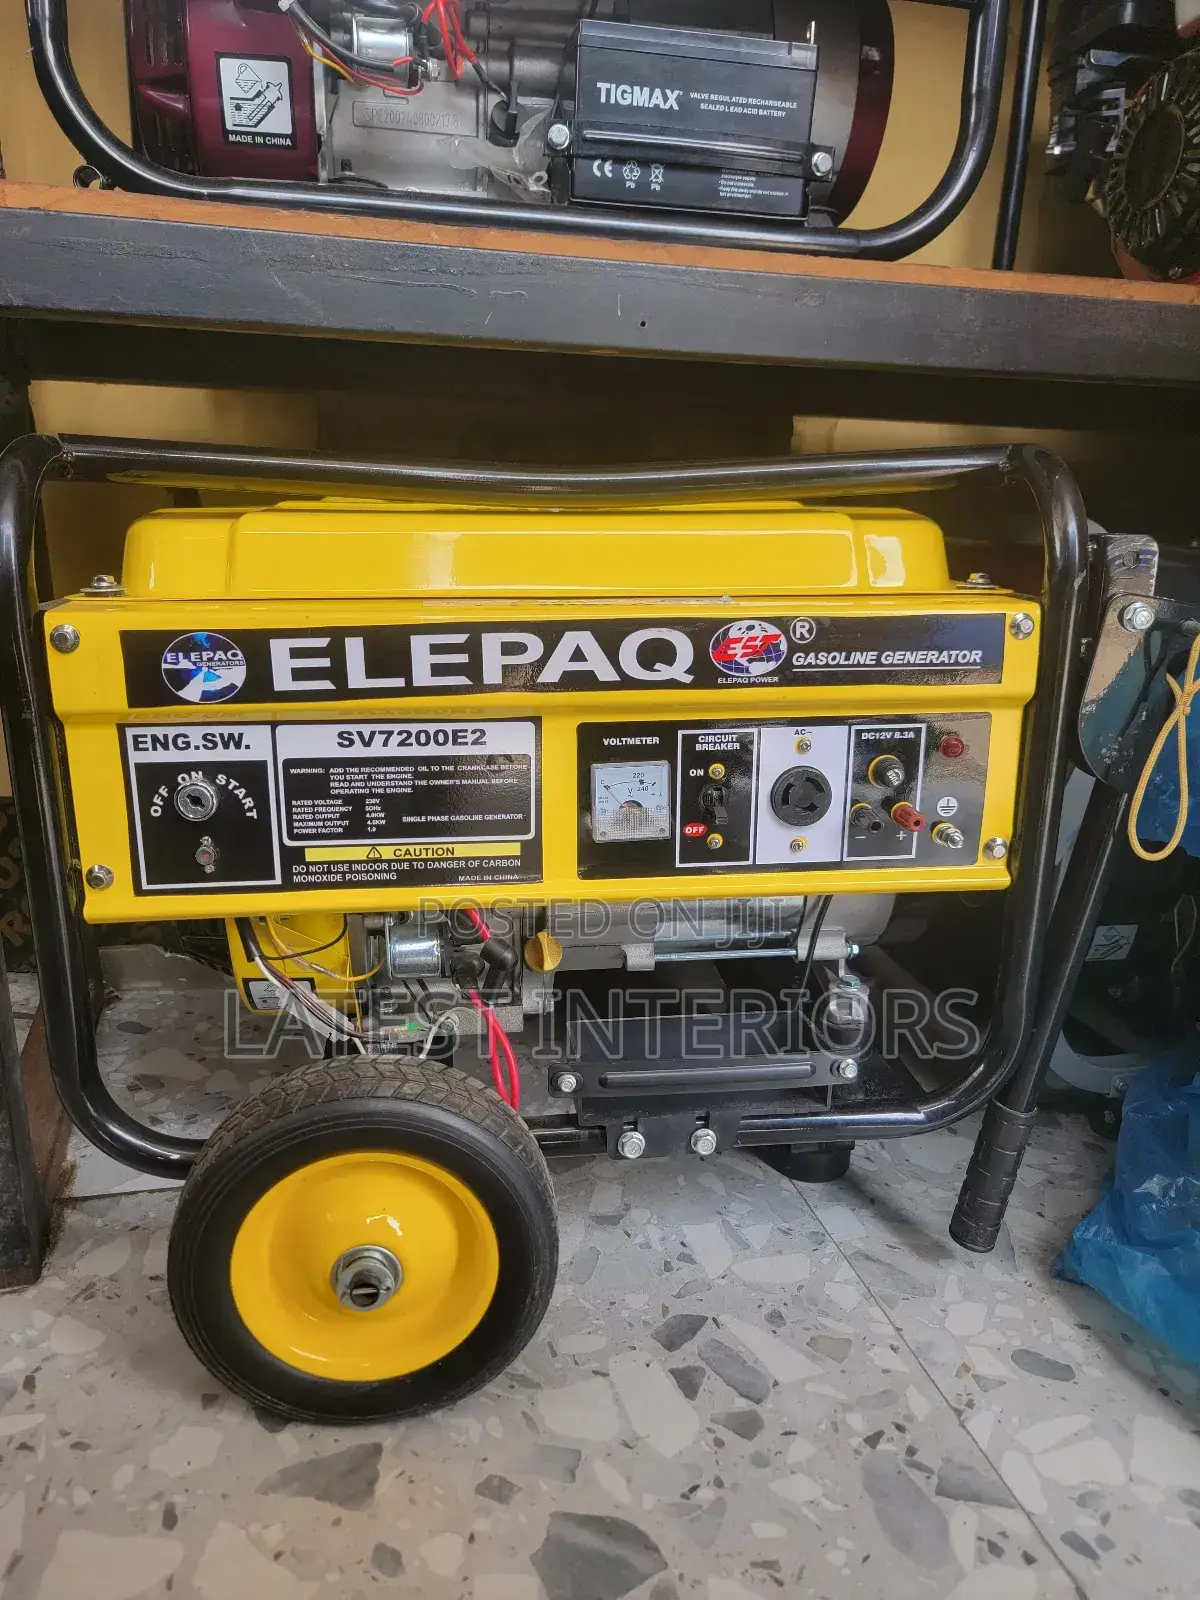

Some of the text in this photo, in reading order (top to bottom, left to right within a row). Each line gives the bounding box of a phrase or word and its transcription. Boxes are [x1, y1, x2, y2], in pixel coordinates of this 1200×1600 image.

[690, 92, 709, 100] VALVE
[748, 98, 798, 109] RECHARGEABLE
[700, 103, 725, 112] SEALED
[743, 107, 758, 115] ACID
[758, 109, 786, 117] BATTERY
[229, 134, 292, 146] MADE IN CHINA
[592, 159, 613, 178] CE
[625, 181, 661, 191] Pb Pb
[166, 649, 243, 662] ELEPAQ
[270, 627, 694, 691] ELEPAQ
[792, 650, 982, 666] GASOLINE GENERATOR
[132, 732, 251, 751] ENG.SW.
[336, 728, 487, 748] SV7200E2
[602, 737, 660, 746] VOLTMETER
[698, 734, 738, 743] CIRCUIT
[861, 731, 915, 740] DC12V 8.3A
[695, 742, 740, 751] BREAKER
[177, 771, 203, 785] ON
[689, 768, 704, 776] ON
[150, 785, 170, 817] OFF
[215, 774, 258, 820] START
[685, 826, 705, 834] OFF
[393, 847, 455, 858] CAUTION
[292, 859, 521, 873] DO NOT USE INDOOR DUE TO DANGER OF CARBON
[293, 872, 397, 883] MONOXIDE POISONING
